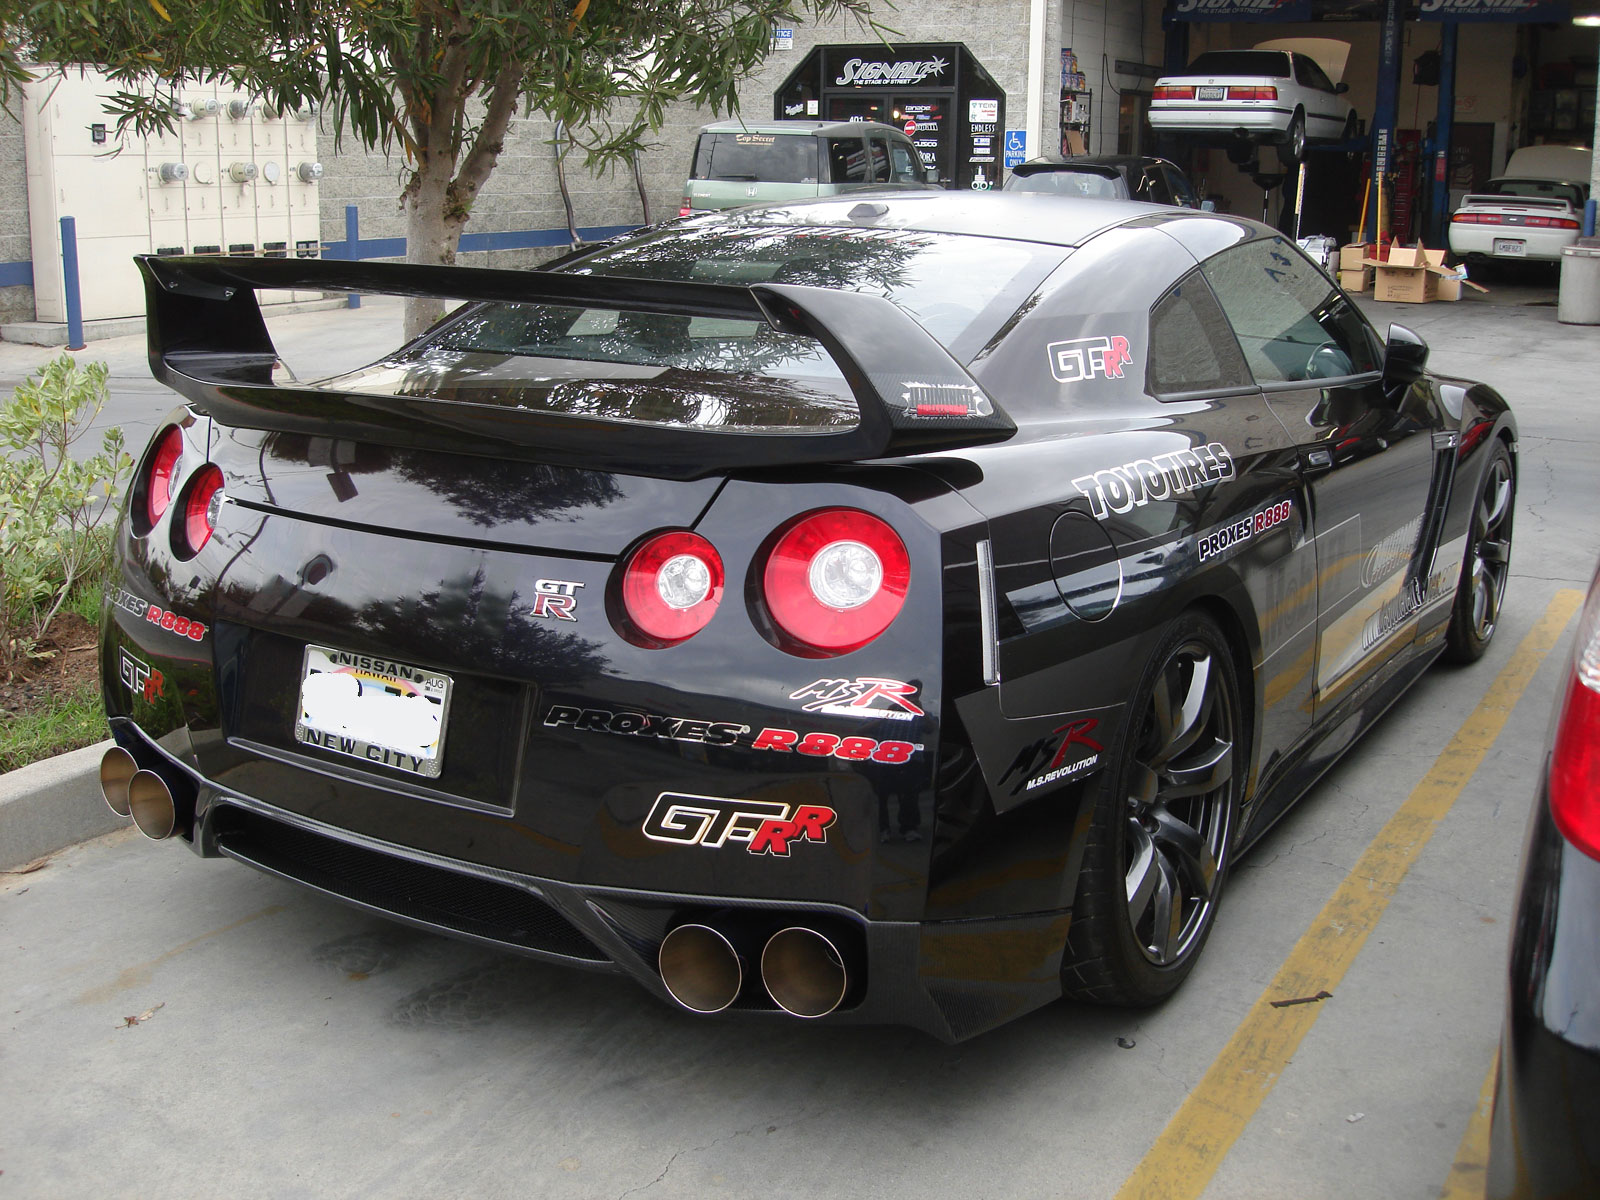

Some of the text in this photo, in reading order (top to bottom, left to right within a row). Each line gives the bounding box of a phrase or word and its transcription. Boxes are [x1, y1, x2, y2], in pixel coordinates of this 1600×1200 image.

[849, 115, 863, 123] 401
[971, 124, 995, 132] ENDLESS
[736, 134, 751, 142] Top
[1005, 150, 1026, 158] PARKING
[1198, 500, 1291, 562] PROXES R888
[146, 604, 208, 641] R888
[339, 652, 412, 679] NISSAN
[425, 678, 444, 689] AUG
[306, 728, 424, 772] NEW CITY
